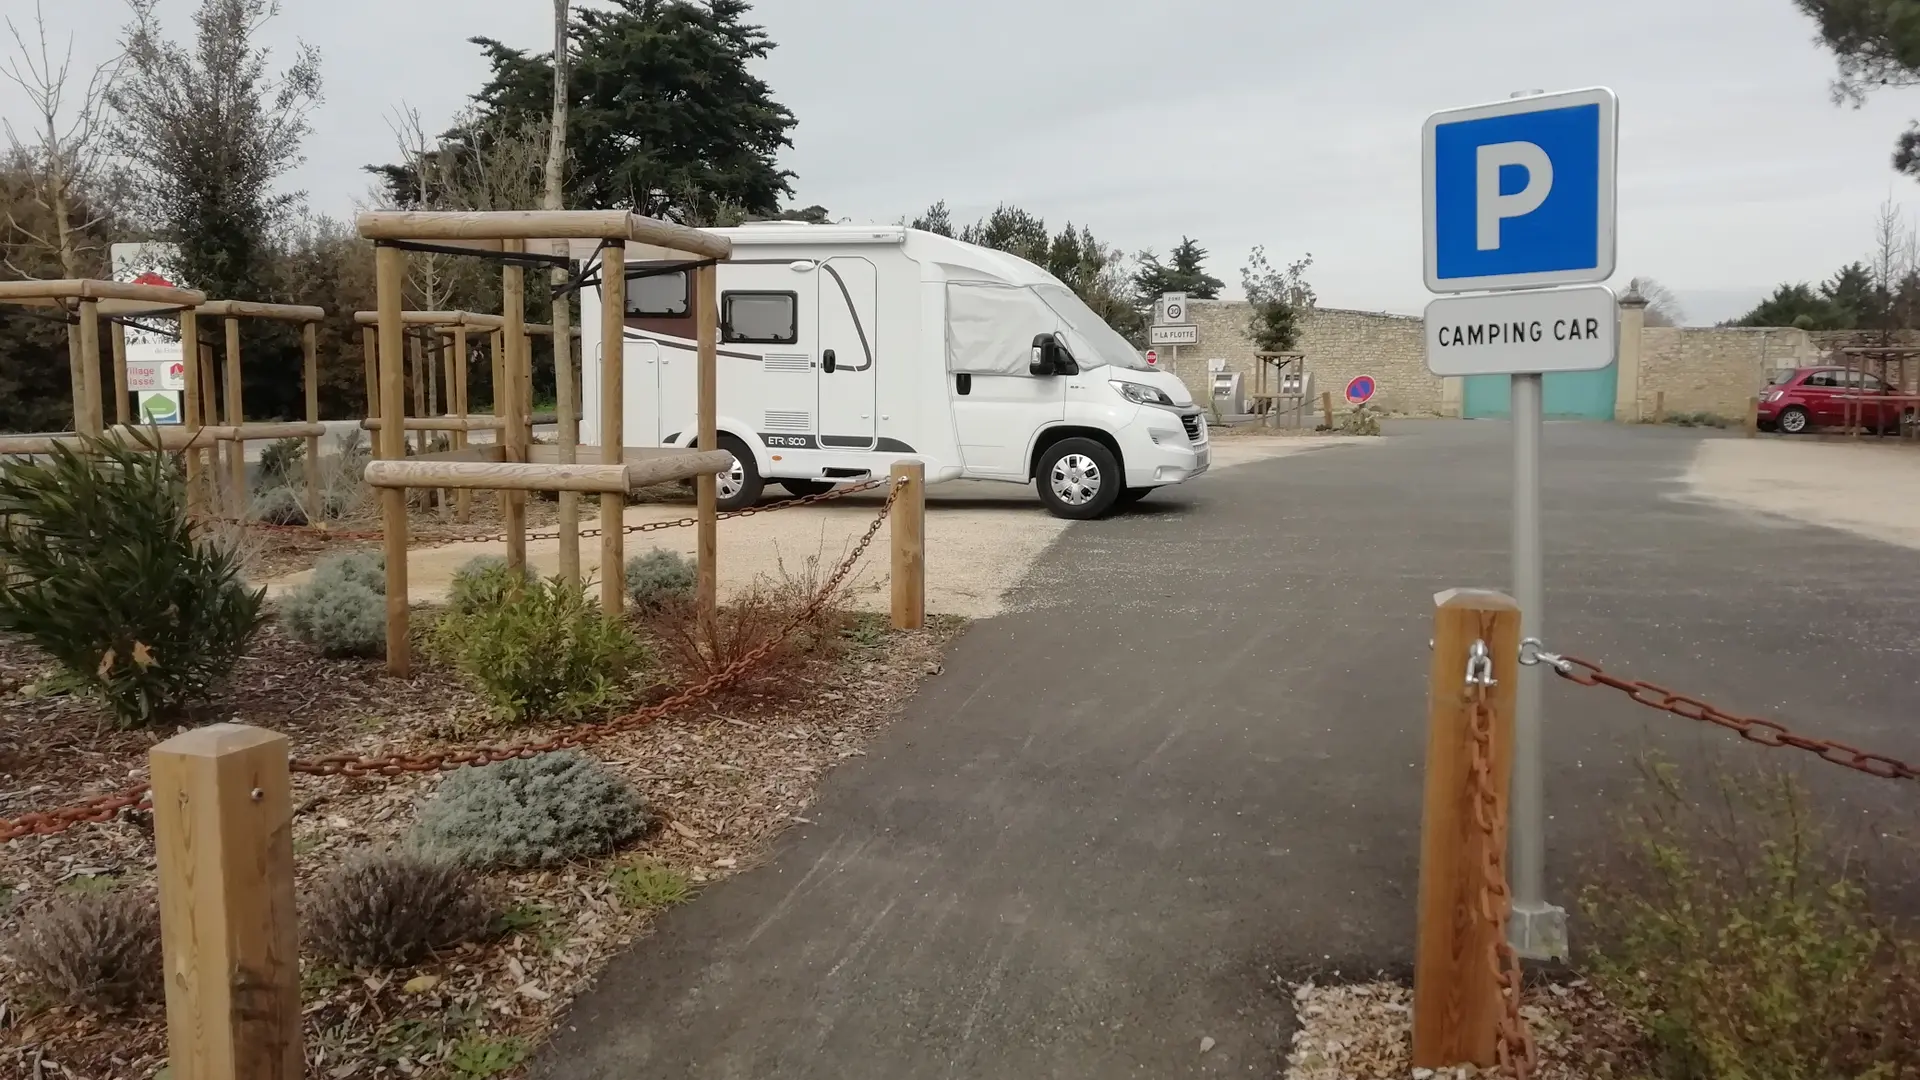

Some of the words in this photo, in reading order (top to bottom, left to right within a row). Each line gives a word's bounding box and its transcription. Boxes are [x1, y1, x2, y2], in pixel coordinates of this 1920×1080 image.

[1476, 140, 1554, 251] P
[1170, 330, 1194, 338] FLOTTE
[1438, 320, 1543, 347] CAMPING
[1553, 317, 1600, 341] CAR
